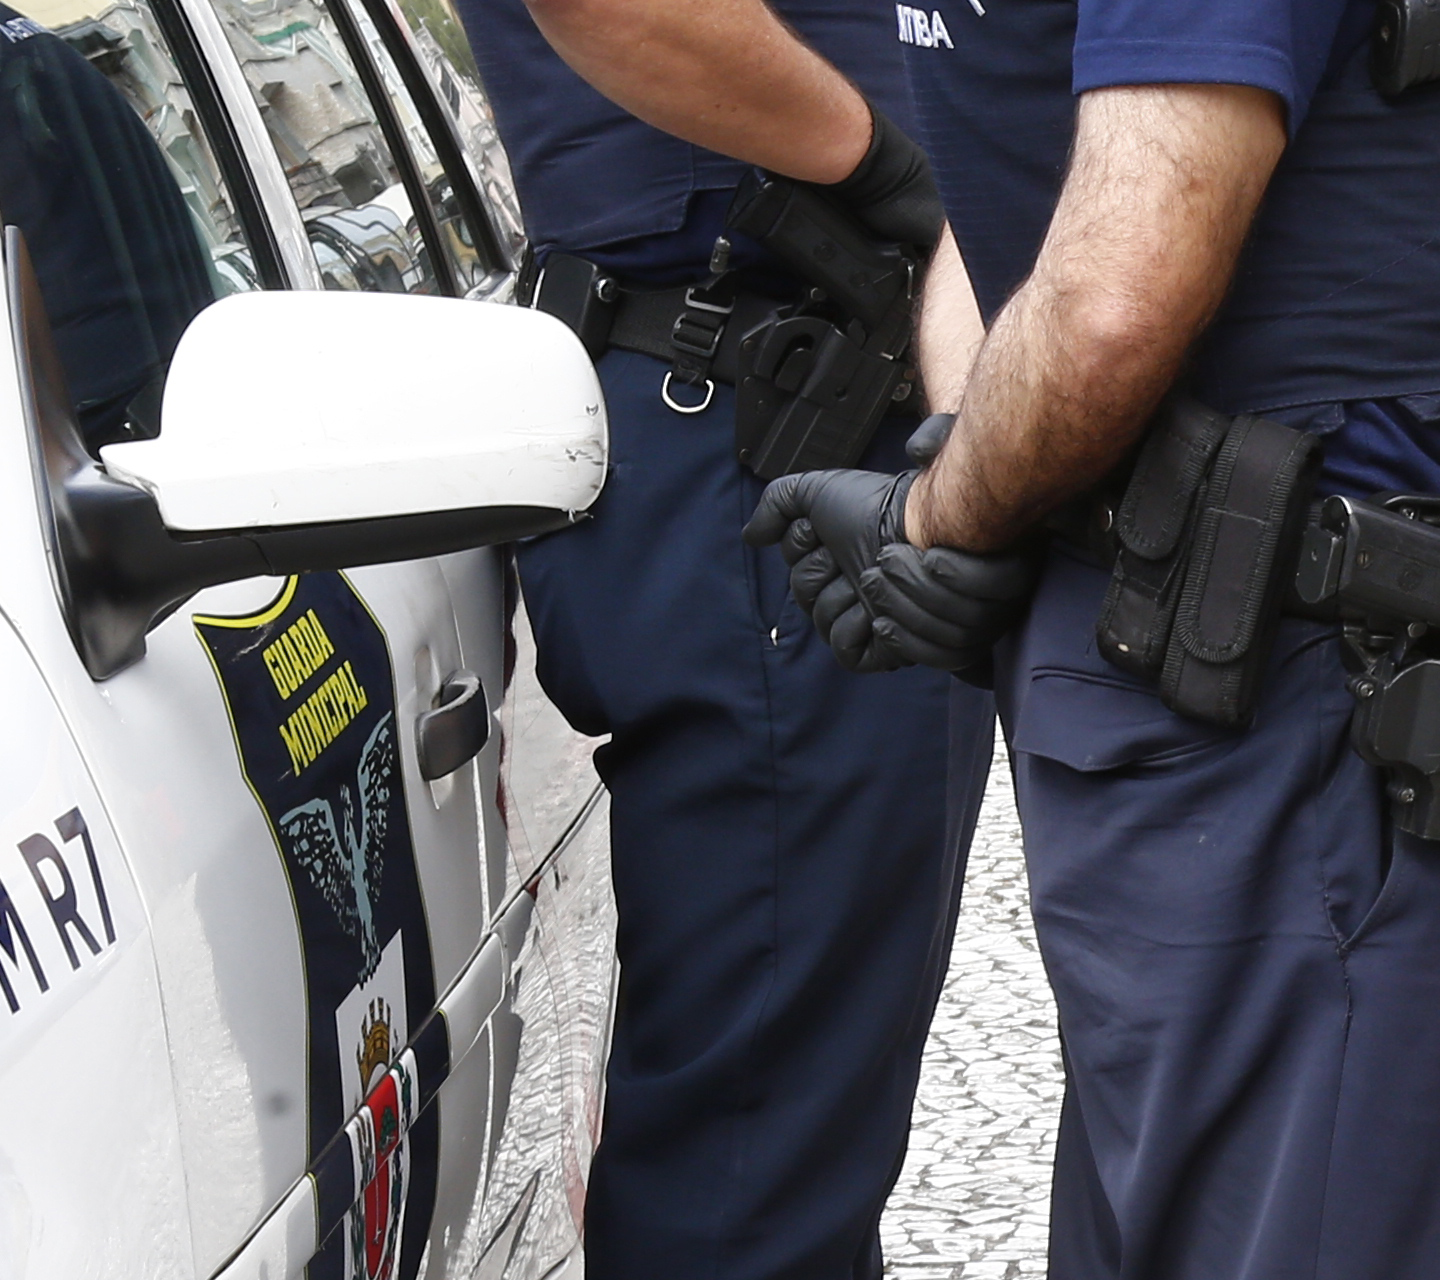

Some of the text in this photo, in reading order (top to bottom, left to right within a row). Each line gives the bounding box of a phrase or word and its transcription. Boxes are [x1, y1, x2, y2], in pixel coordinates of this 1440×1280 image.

[263, 608, 335, 701] GUARDA
[278, 659, 368, 778] MUNICIPAL
[16, 806, 117, 971] R7
